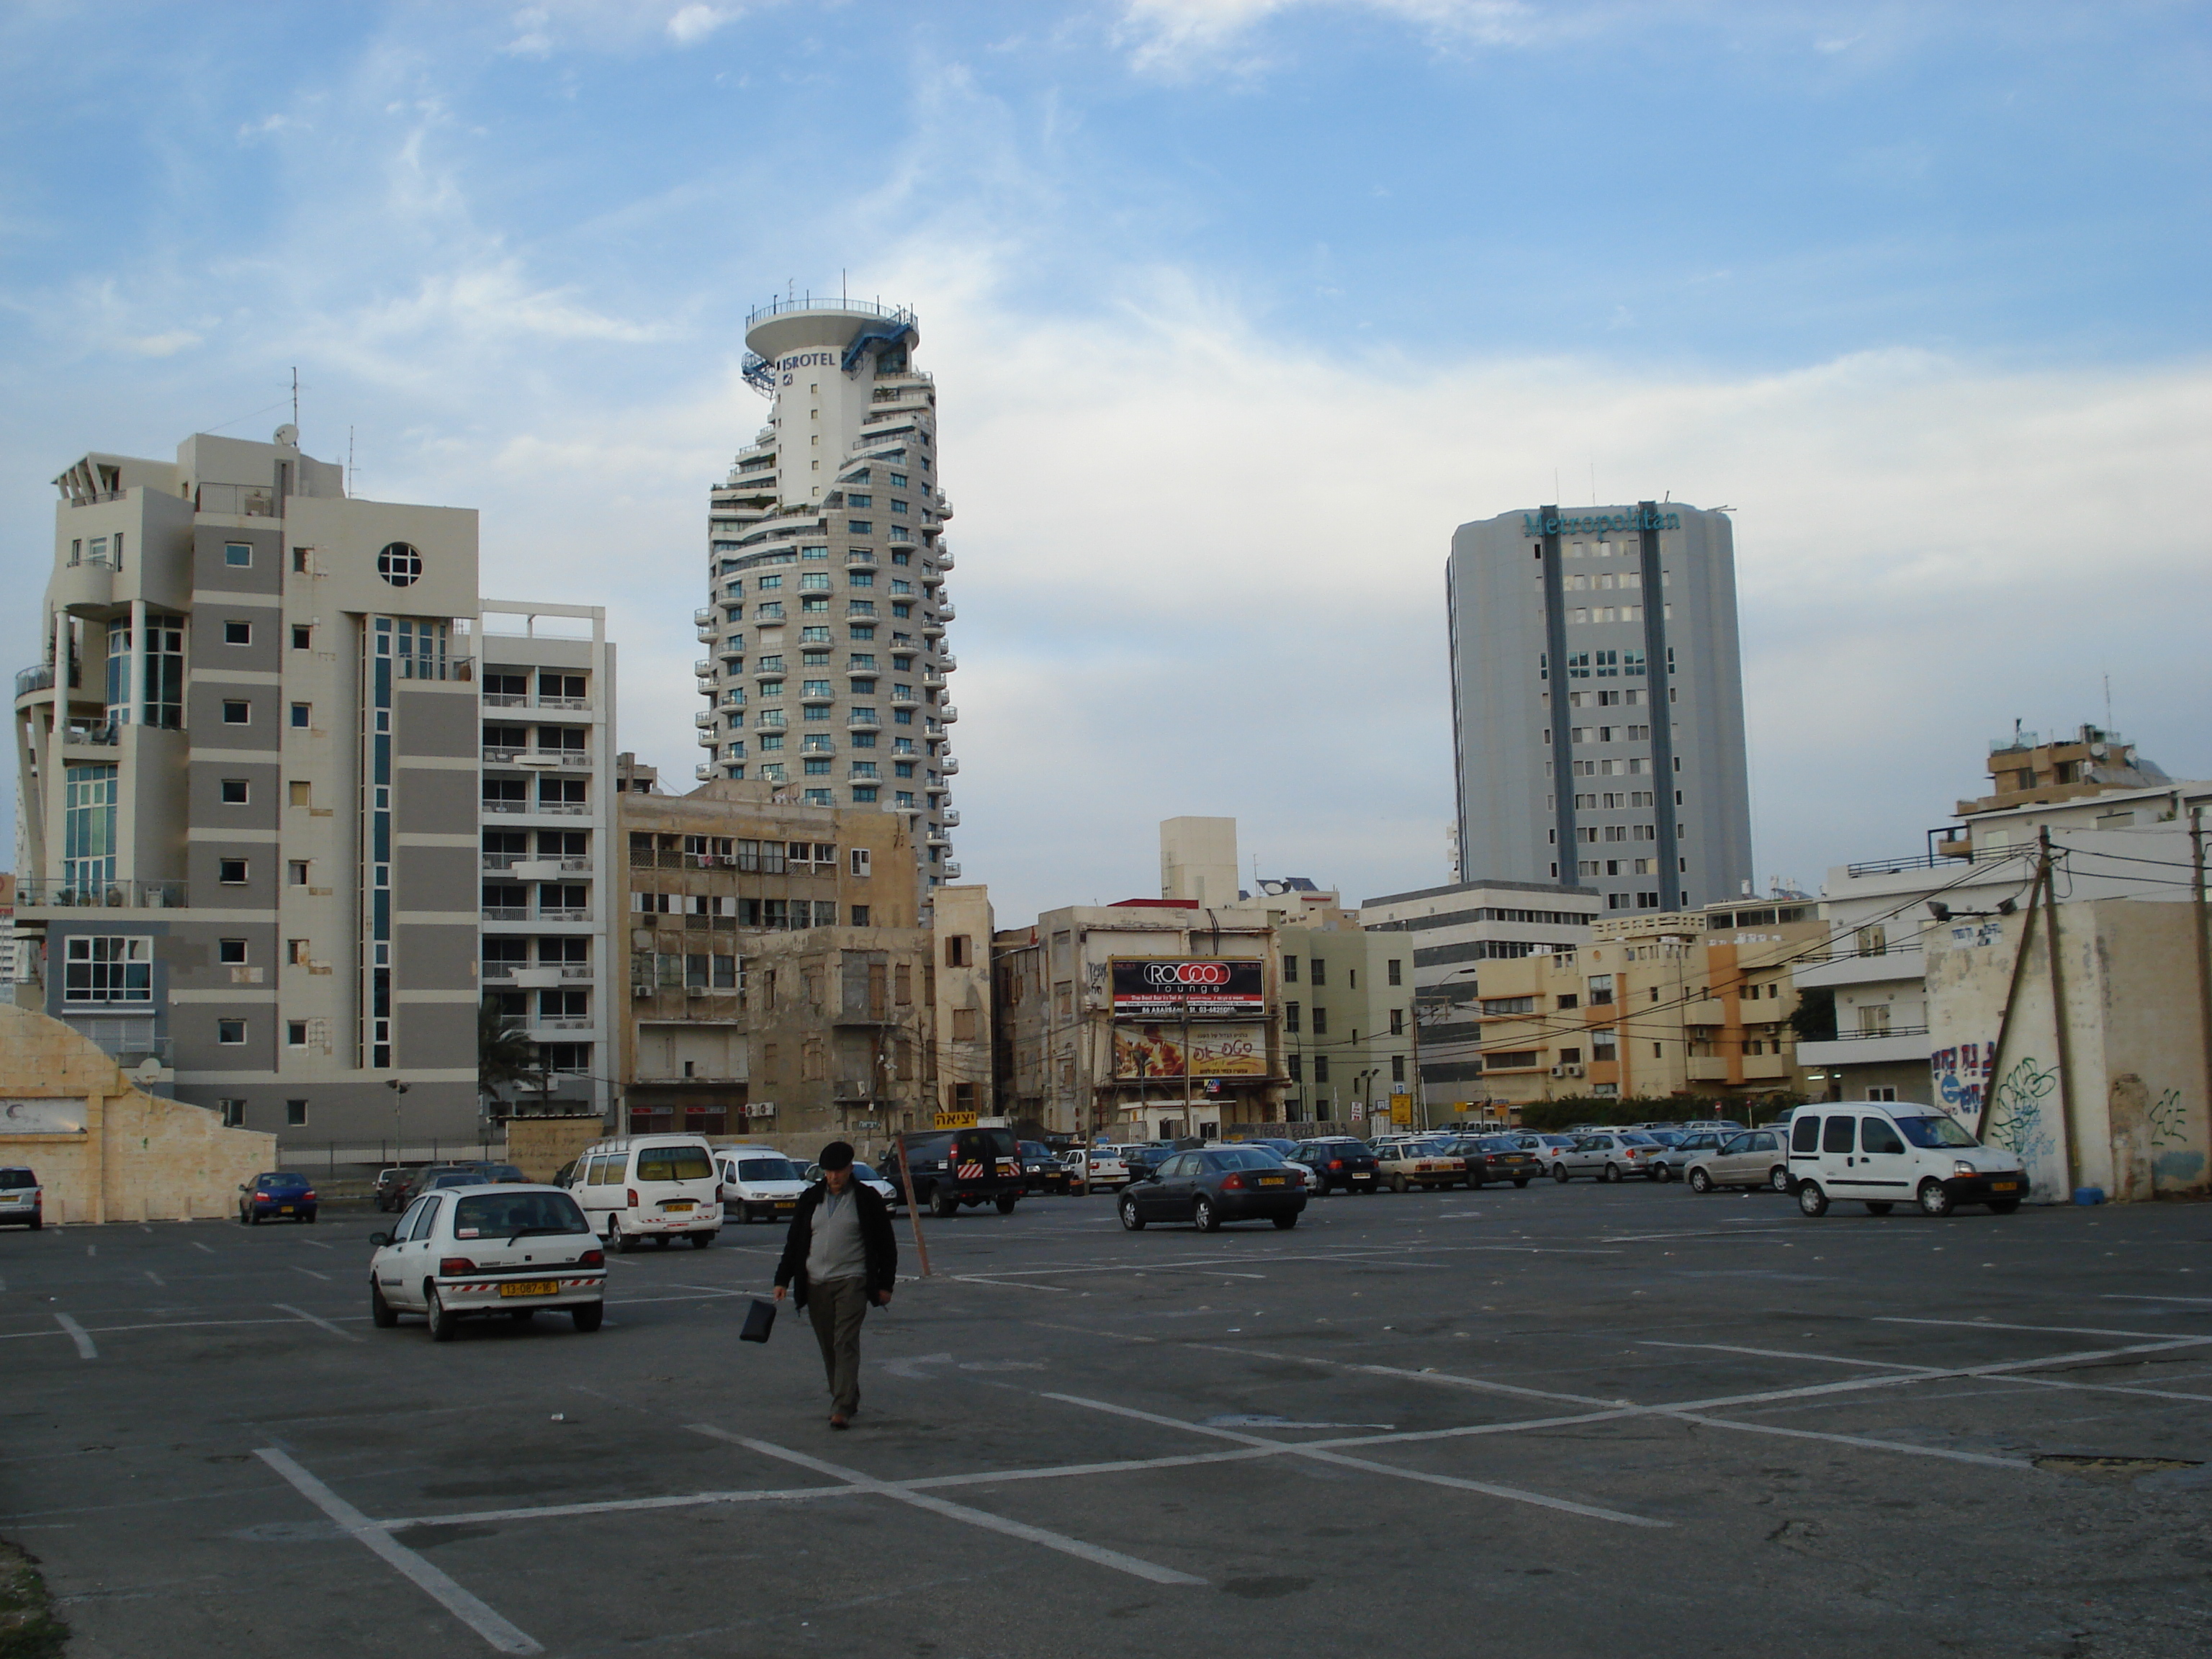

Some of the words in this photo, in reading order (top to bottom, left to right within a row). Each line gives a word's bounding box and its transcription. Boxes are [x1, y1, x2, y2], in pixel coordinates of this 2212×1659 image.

[782, 352, 836, 372] ISROTEL
[1524, 507, 1681, 541] Metropolitan
[1150, 963, 1218, 984] ROCCO
[1156, 984, 1220, 994] lounge
[935, 1113, 976, 1126] יציאה
[505, 1282, 552, 1295] 13-087-16
